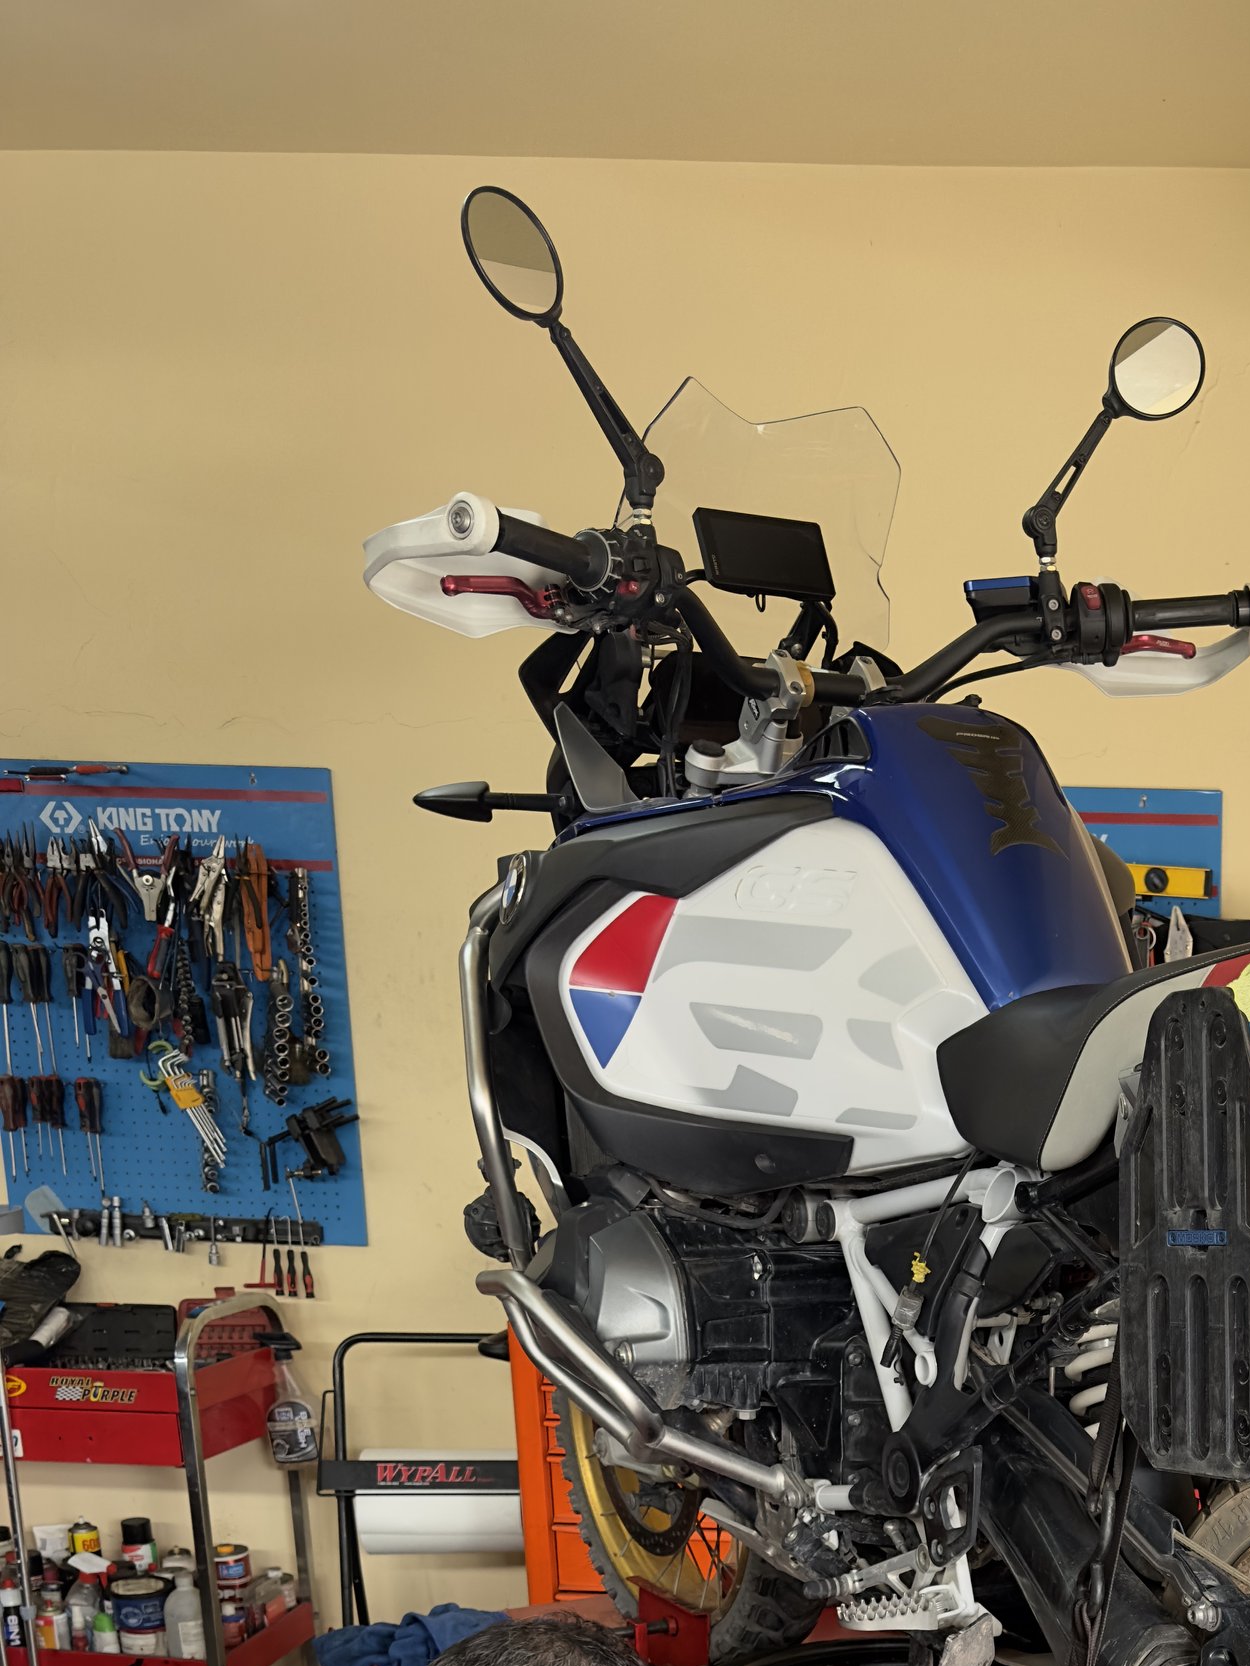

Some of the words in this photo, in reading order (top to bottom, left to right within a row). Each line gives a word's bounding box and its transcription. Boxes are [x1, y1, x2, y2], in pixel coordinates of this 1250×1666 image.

[97, 806, 153, 831] KING
[155, 807, 221, 832] TONY
[49, 1376, 92, 1388] ROYAL
[81, 1382, 137, 1403] PURPLE
